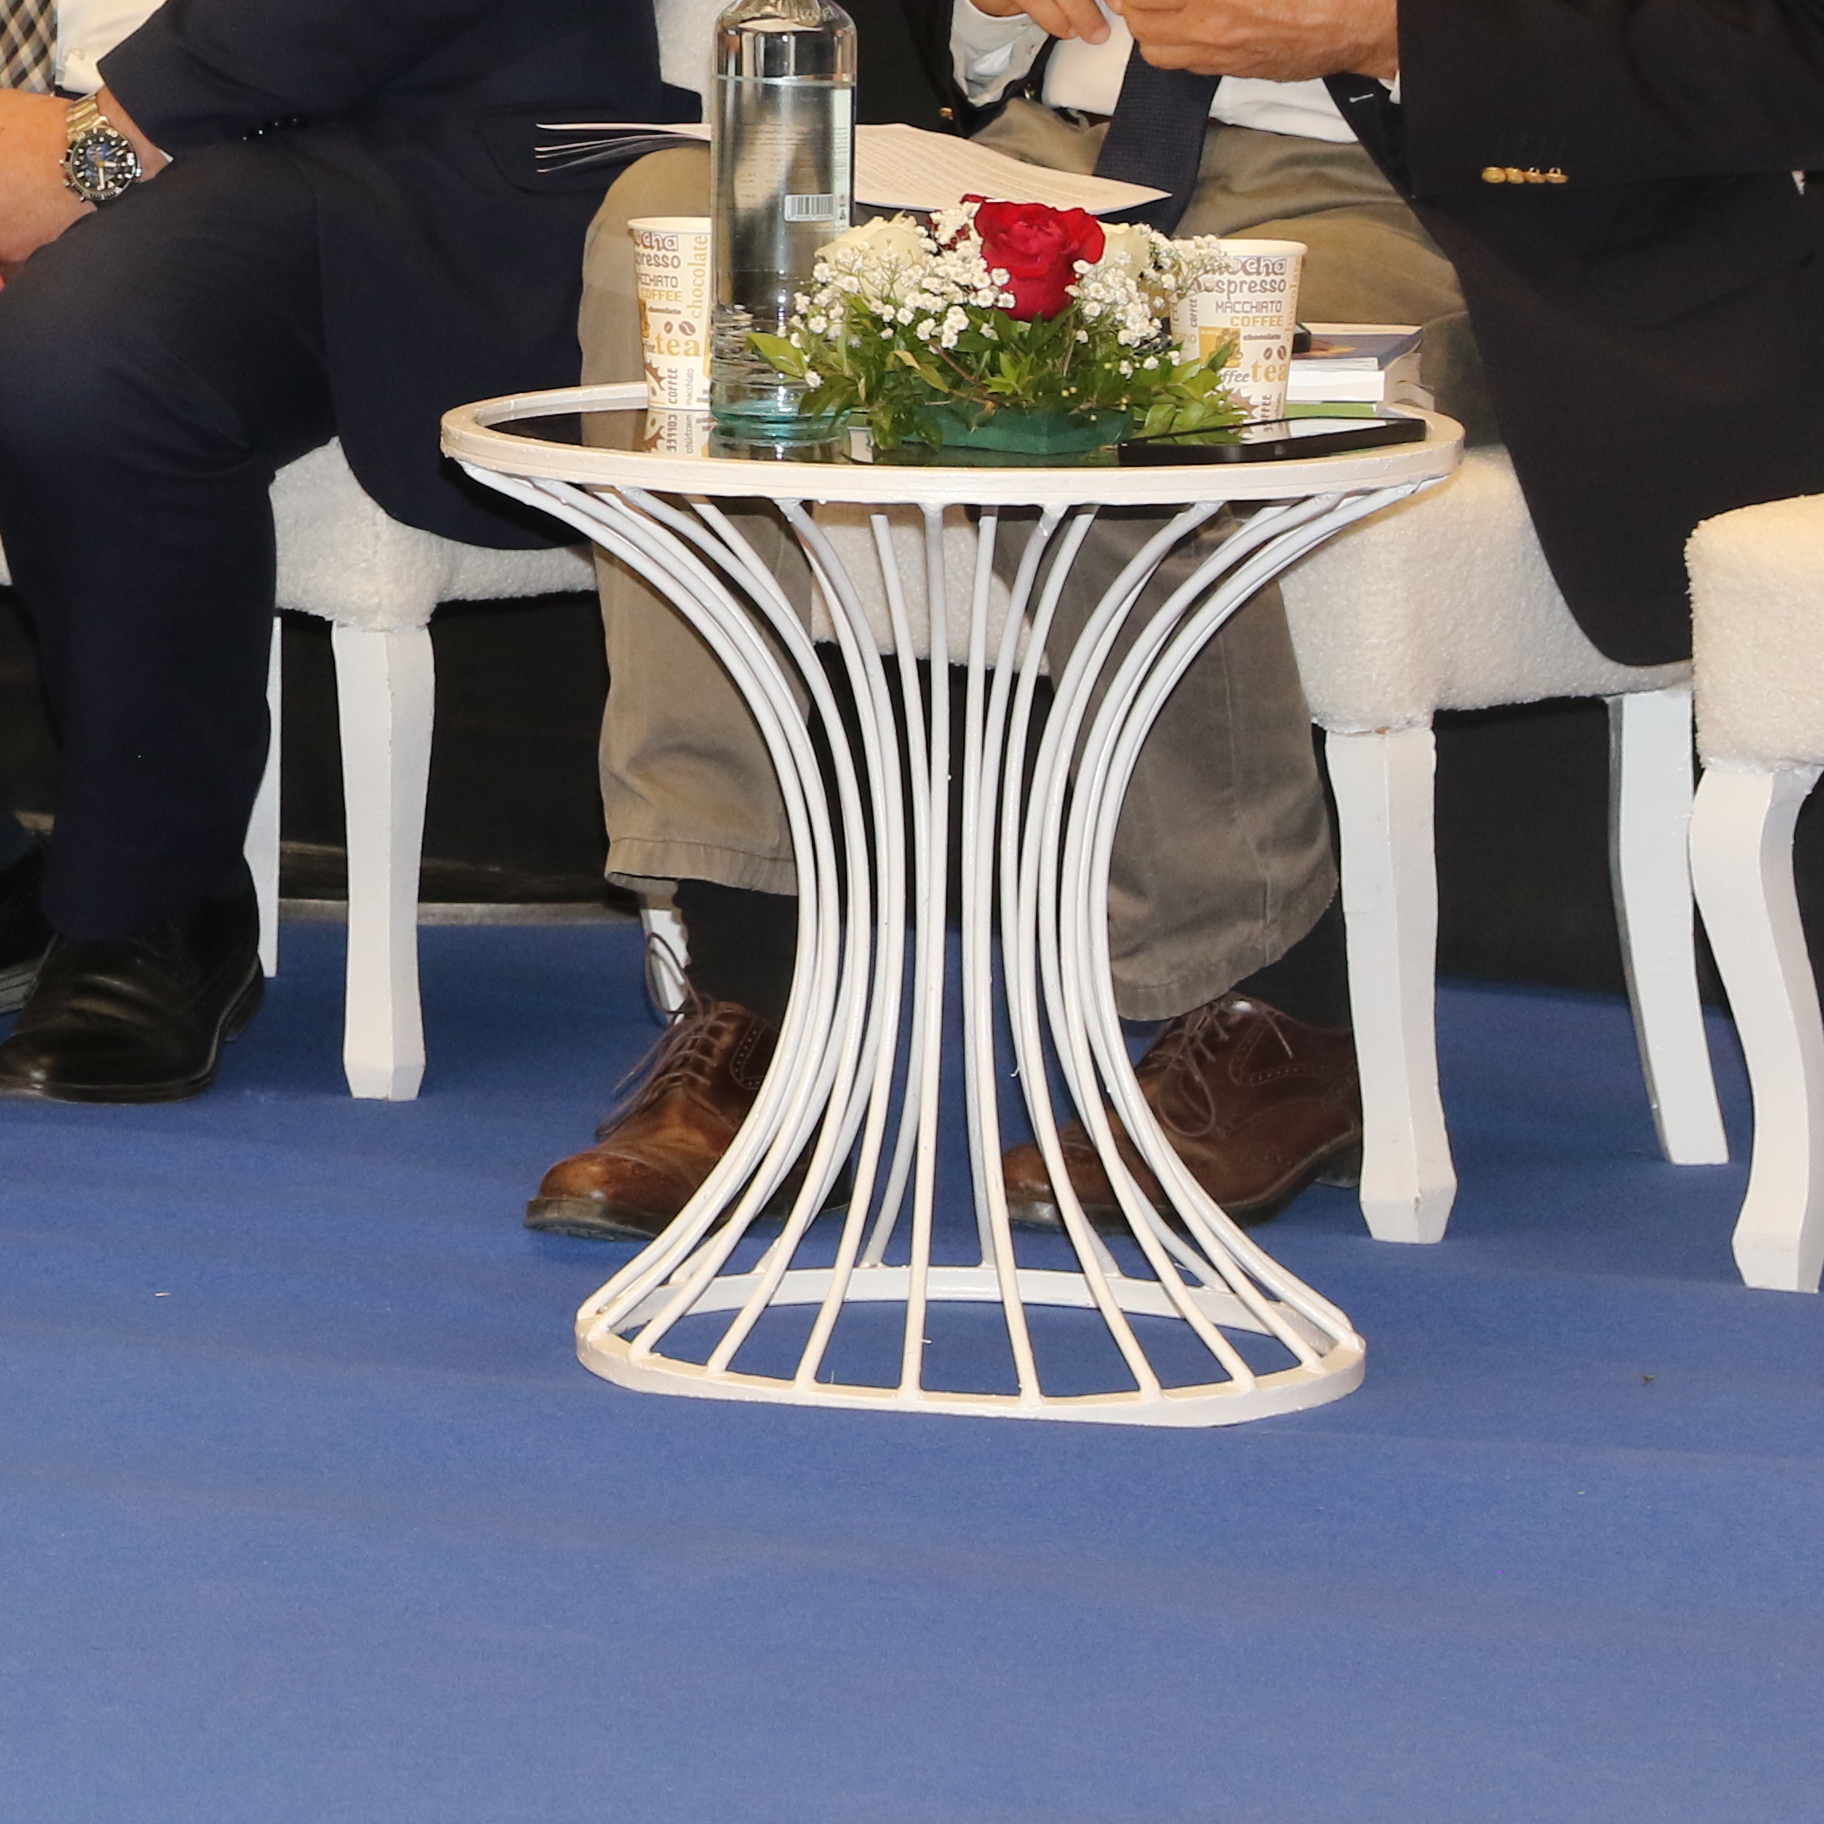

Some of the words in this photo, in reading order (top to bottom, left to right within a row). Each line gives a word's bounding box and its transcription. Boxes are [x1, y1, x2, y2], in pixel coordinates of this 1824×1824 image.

[686, 235, 709, 319] chocolate
[1209, 279, 1287, 300] spresso
[1215, 300, 1283, 314] MACCHIATO
[1229, 315, 1283, 327] COFFEE
[655, 333, 701, 357] tea
[1251, 360, 1287, 384] tea
